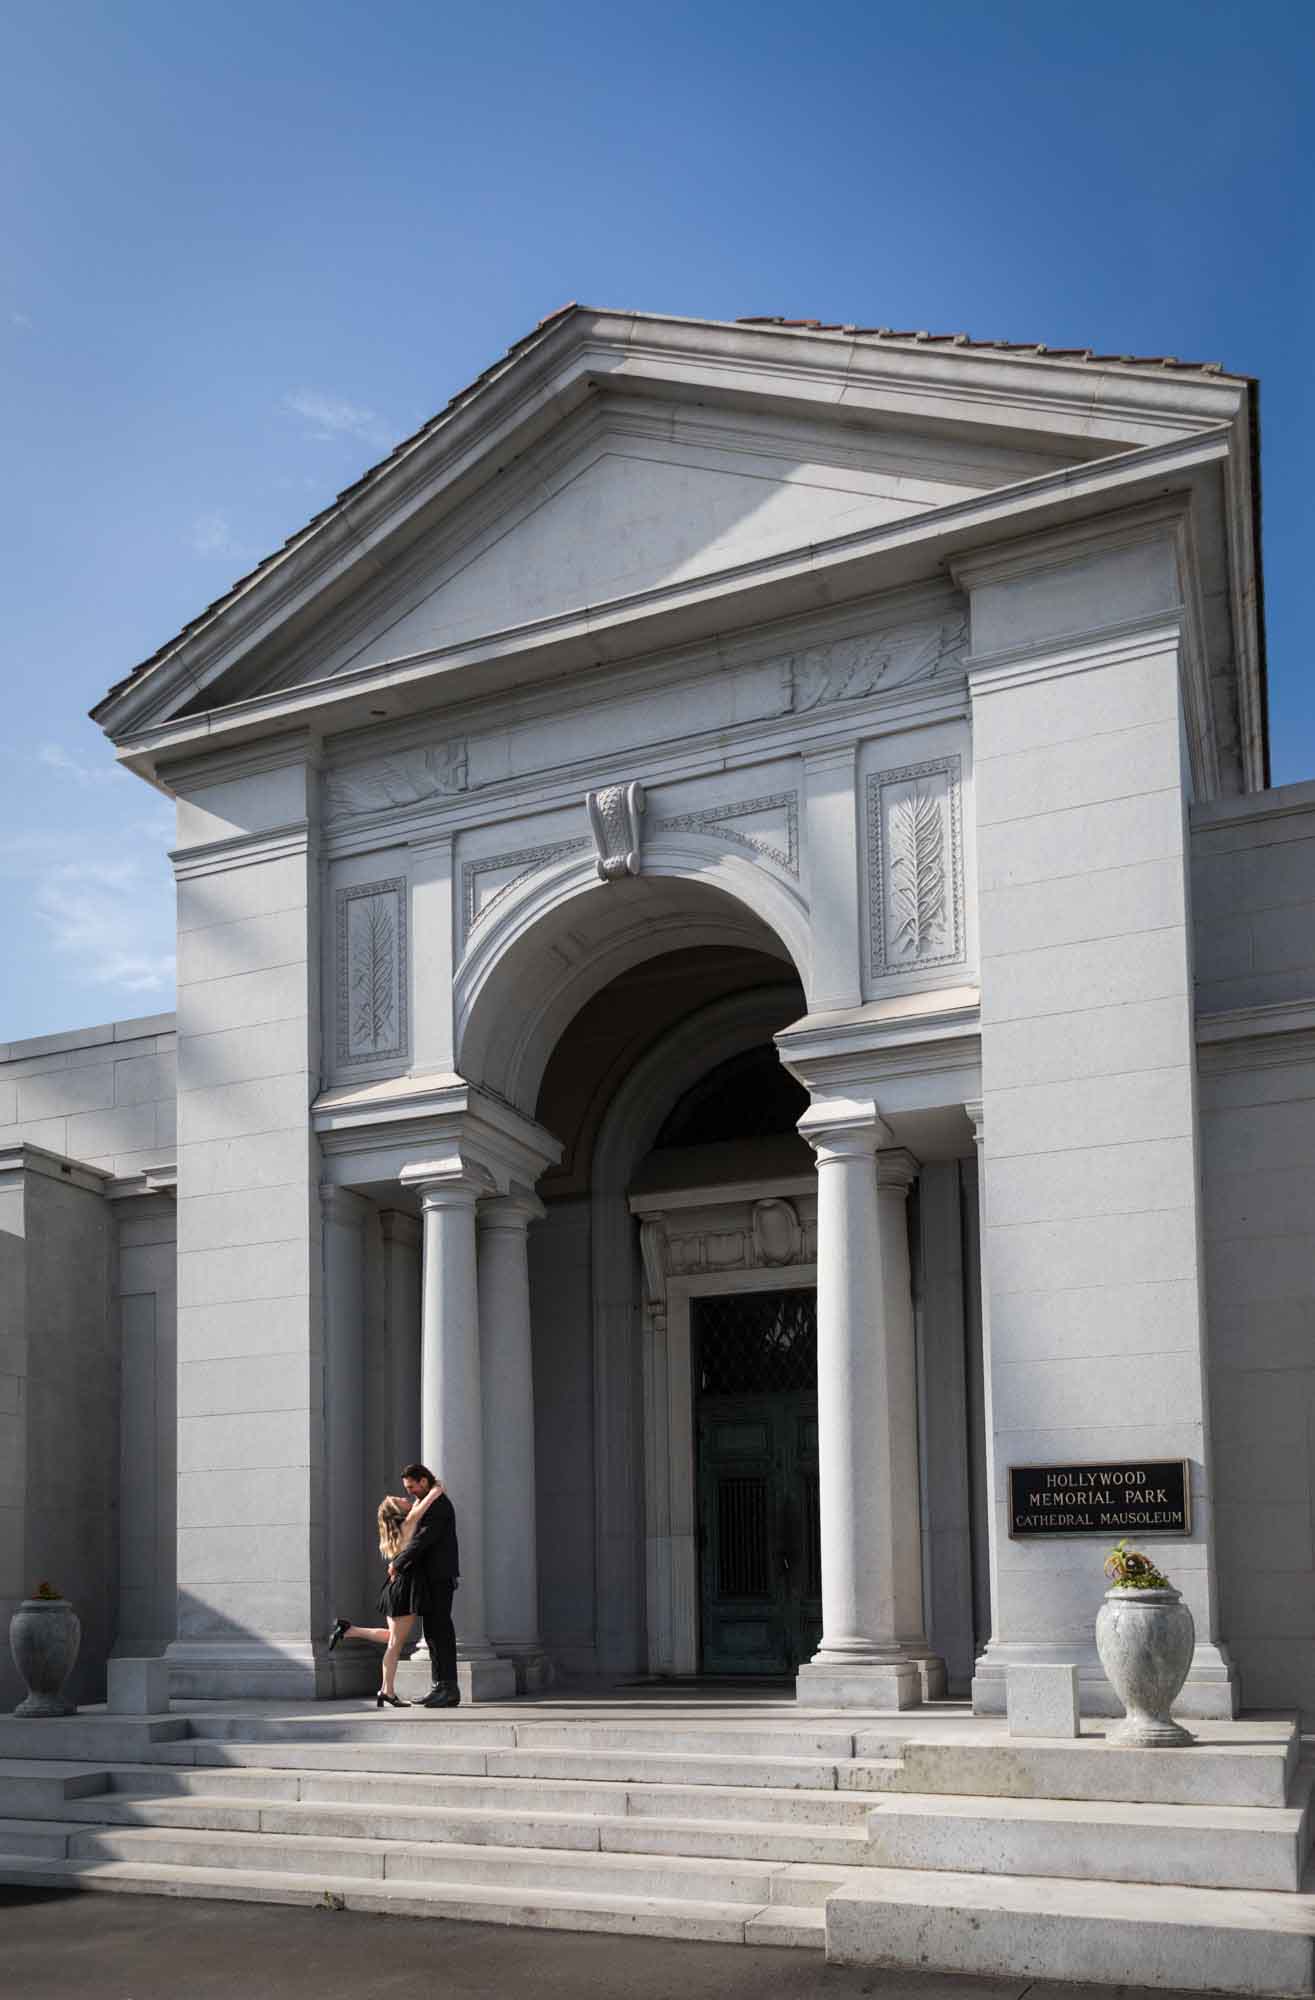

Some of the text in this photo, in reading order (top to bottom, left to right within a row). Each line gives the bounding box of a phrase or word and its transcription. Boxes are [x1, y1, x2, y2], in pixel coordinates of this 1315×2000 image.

[1047, 1471, 1146, 1487] HOLLYWOOD
[1029, 1489, 1168, 1506] MEMORIAL PARK
[1016, 1511, 1182, 1527] CATHEDRAL MAUSOLEUM
